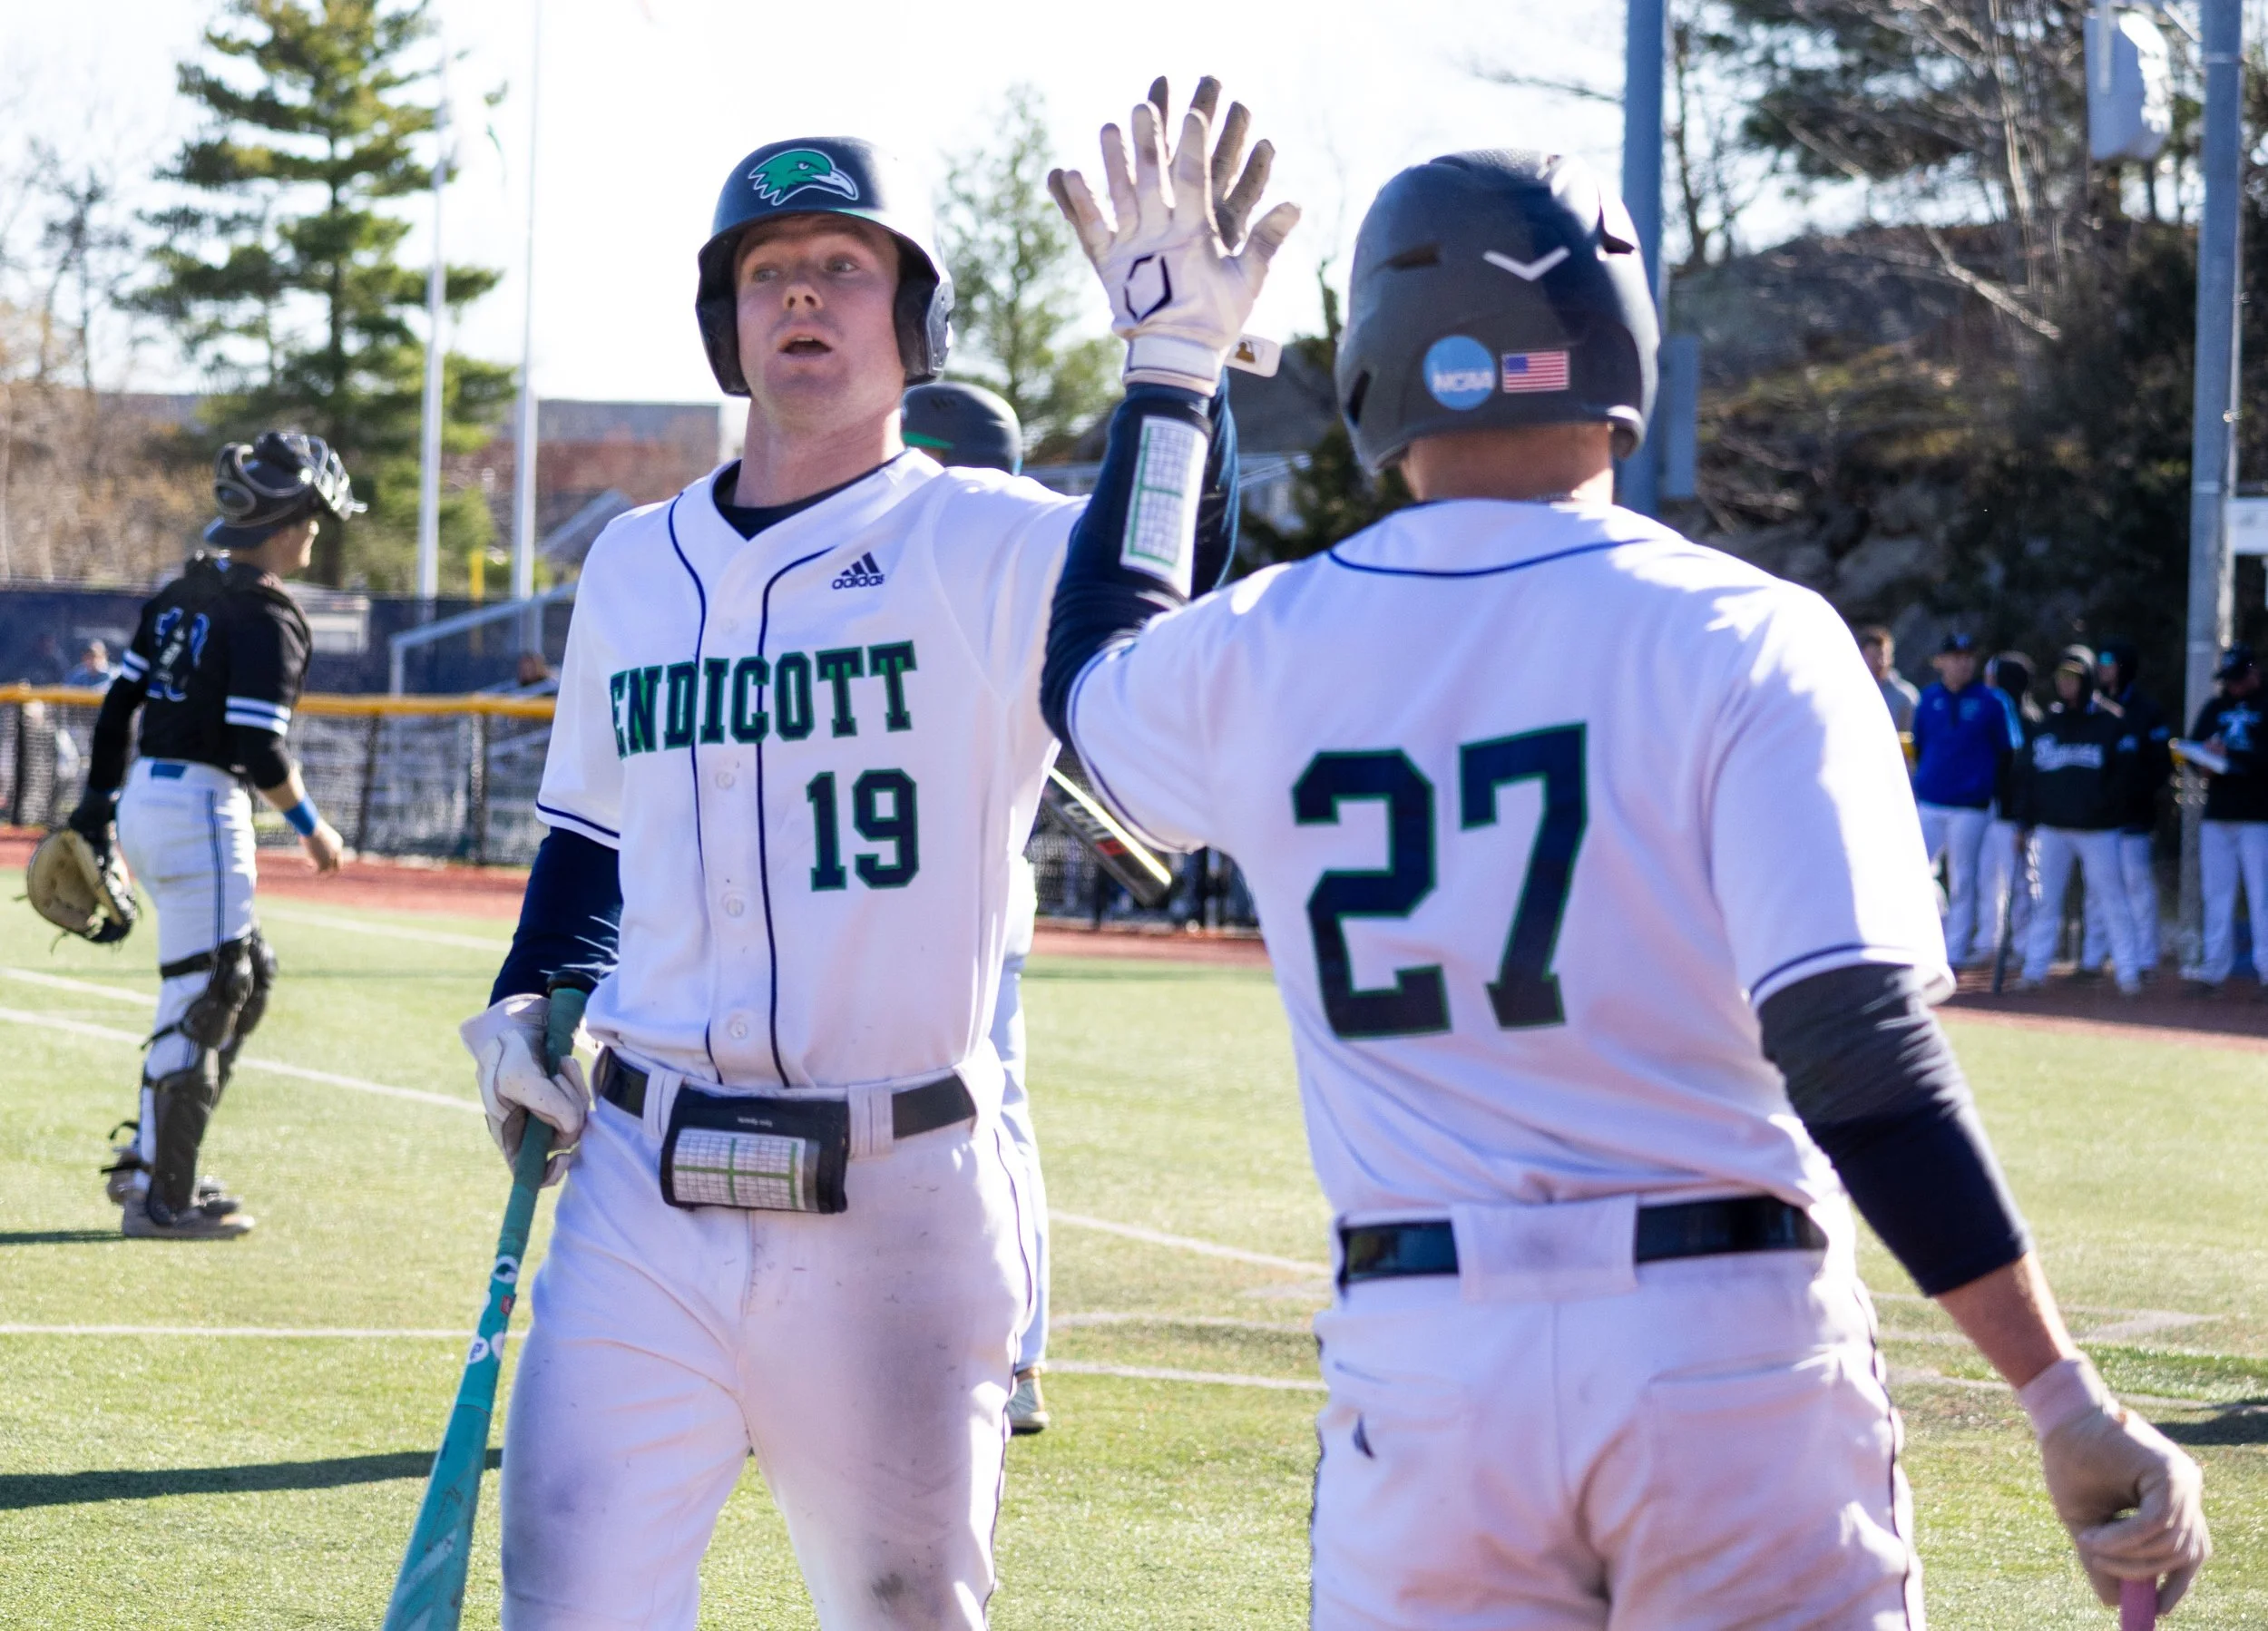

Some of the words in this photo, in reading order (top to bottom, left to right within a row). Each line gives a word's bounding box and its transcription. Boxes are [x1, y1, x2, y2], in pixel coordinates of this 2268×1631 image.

[831, 572, 885, 590] adidas
[610, 640, 917, 760] ENDICOTT
[806, 767, 920, 892] 19
[1291, 720, 1589, 1040] 27
